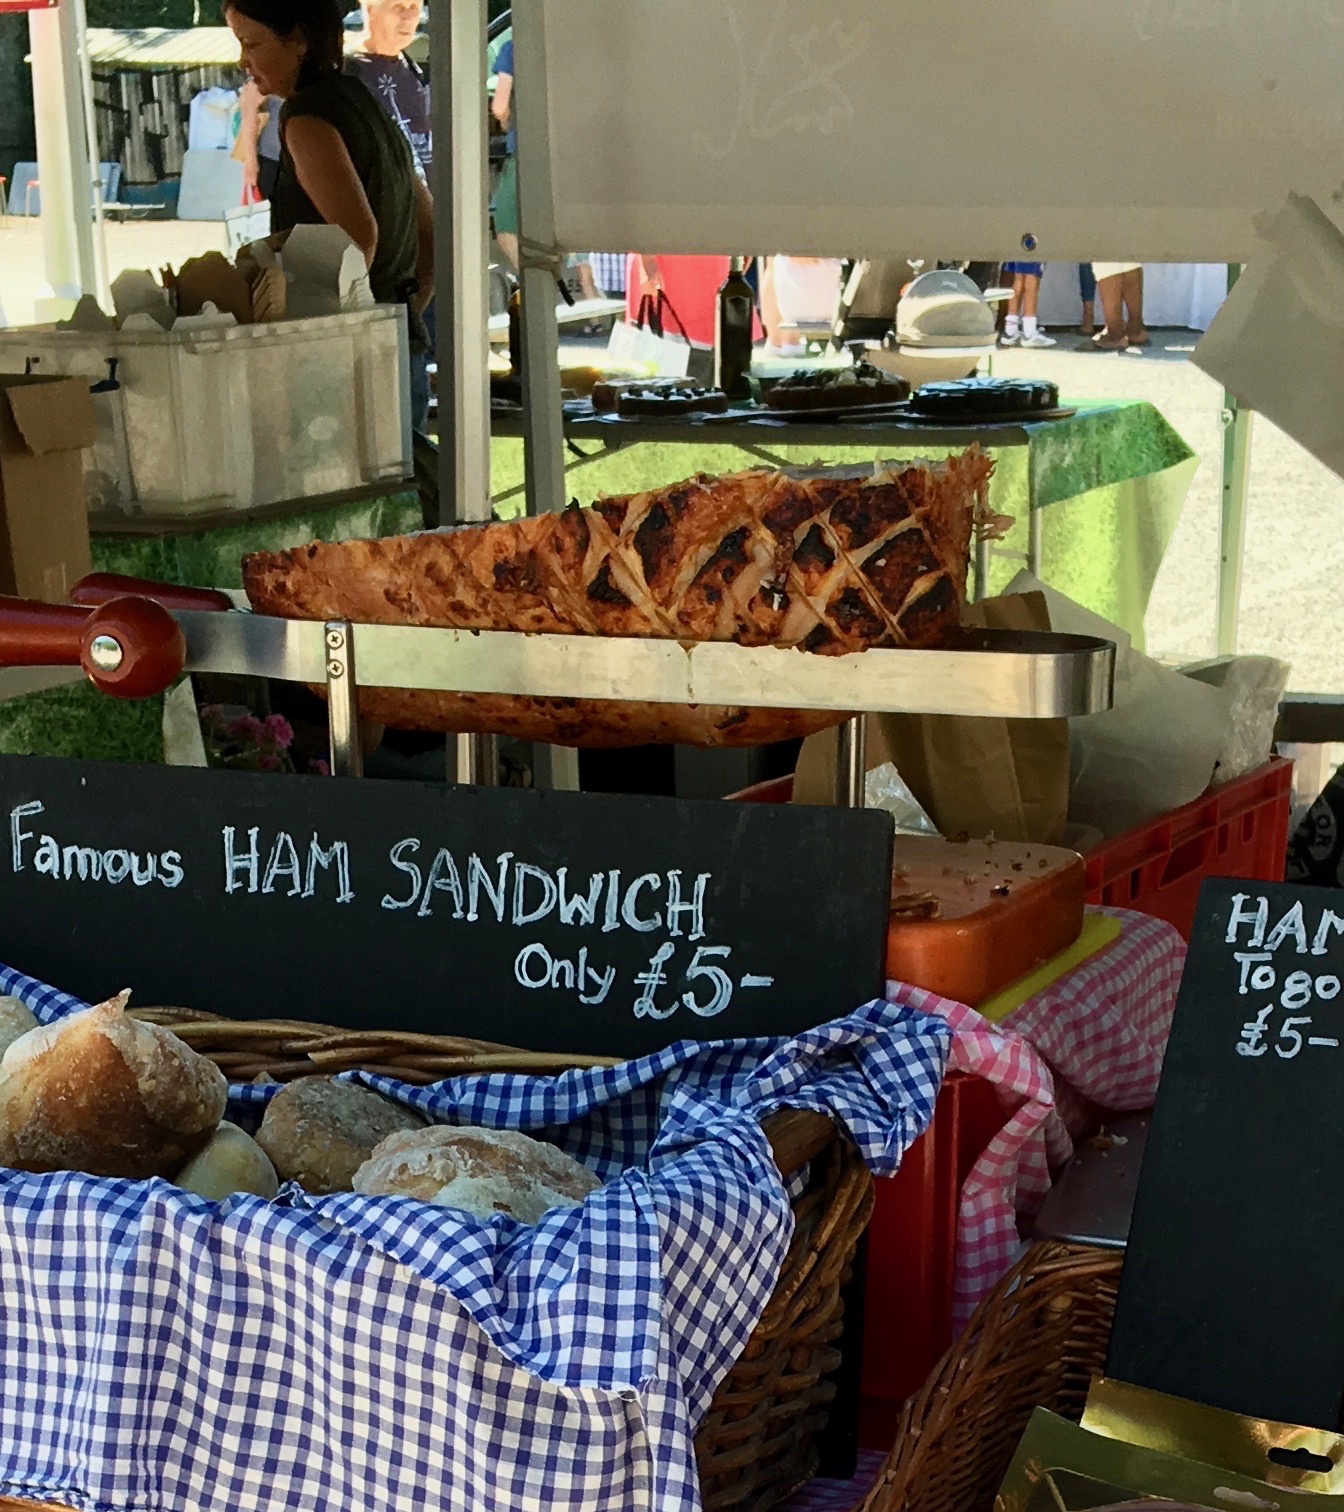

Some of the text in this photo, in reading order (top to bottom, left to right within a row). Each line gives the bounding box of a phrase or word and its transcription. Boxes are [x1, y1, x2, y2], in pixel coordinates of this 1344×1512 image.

[9, 799, 712, 942] Famous HAM SANDWICH
[513, 942, 616, 1006] Only
[1233, 951, 1277, 995] To
